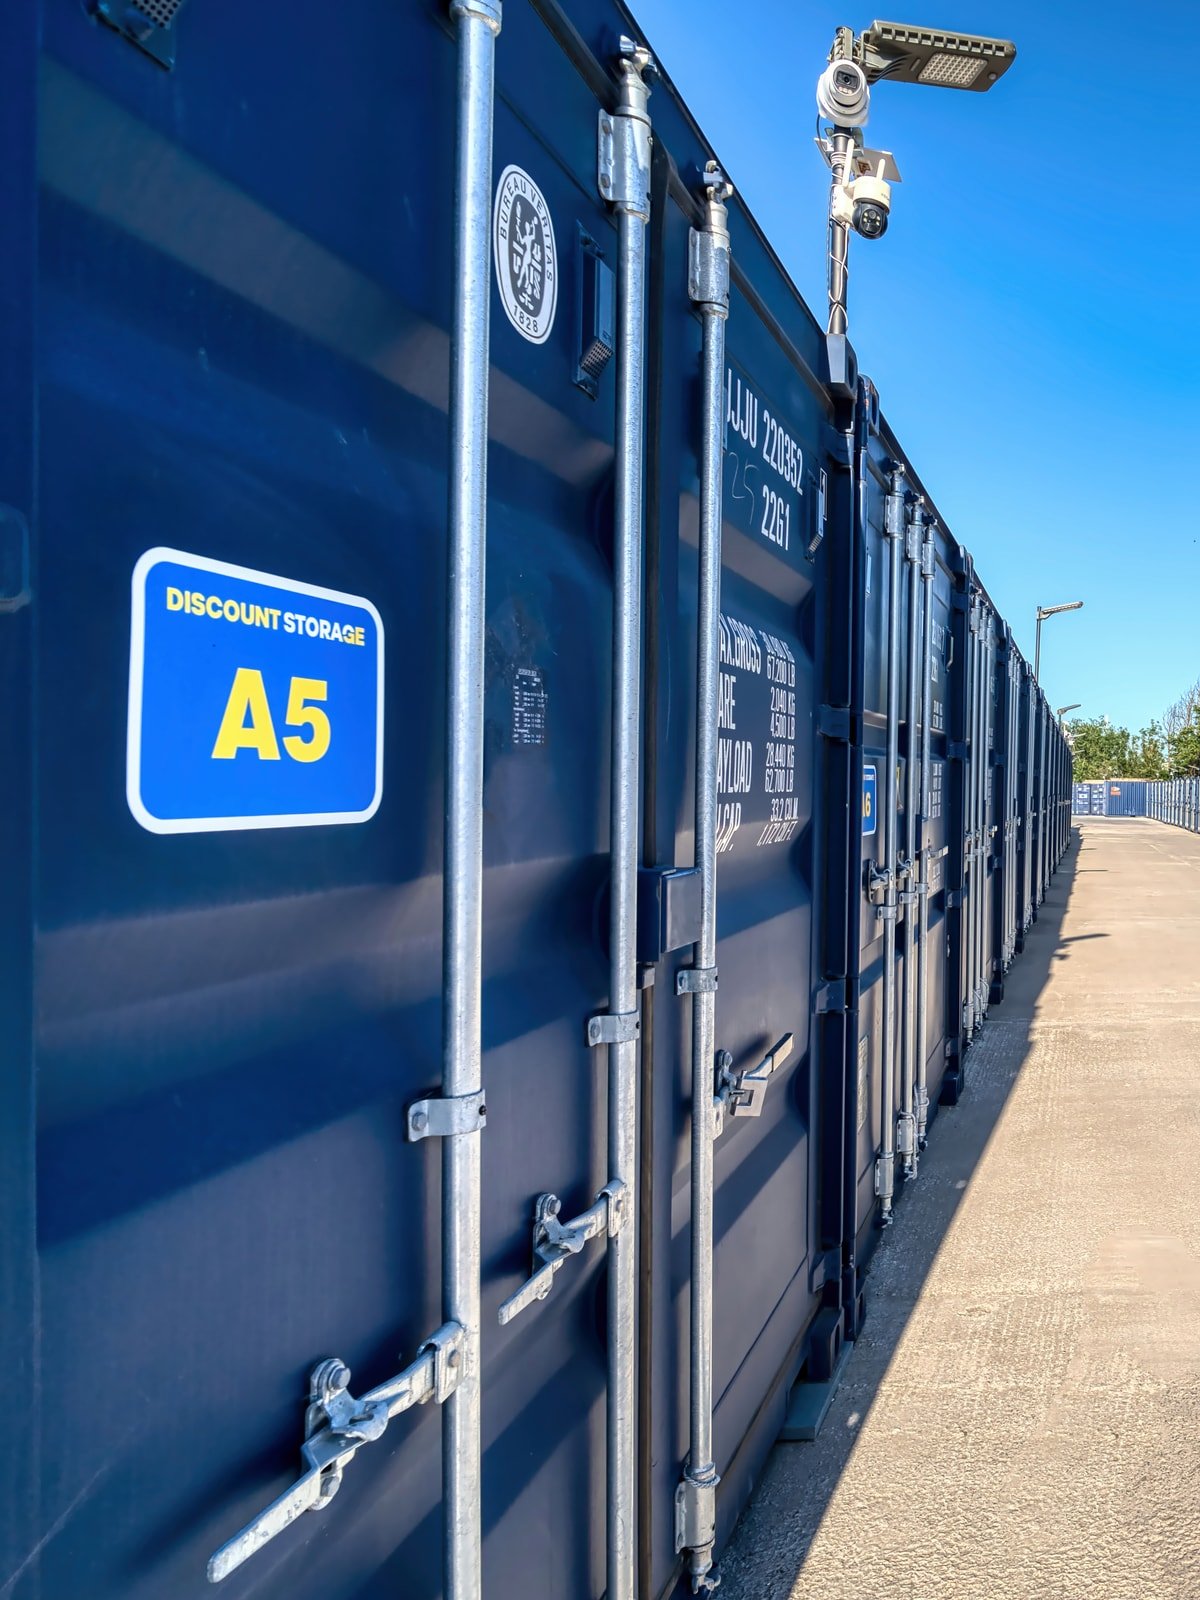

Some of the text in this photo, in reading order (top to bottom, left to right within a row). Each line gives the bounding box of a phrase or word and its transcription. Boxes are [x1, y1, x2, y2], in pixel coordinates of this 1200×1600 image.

[500, 177, 553, 282] BUREAU VERITAS
[513, 304, 539, 334] 1828
[727, 367, 804, 496] JJJU 220352
[761, 483, 790, 552] 22G1
[166, 586, 365, 647] DISCOUNT STORAGE
[718, 612, 762, 675] AX.GROSS
[717, 671, 737, 730] ARE
[787, 662, 796, 688] LB
[211, 667, 332, 763] A5
[787, 716, 796, 740] LB
[716, 738, 752, 794] AYLOAD
[786, 768, 794, 793] LB
[862, 791, 871, 818] 6
